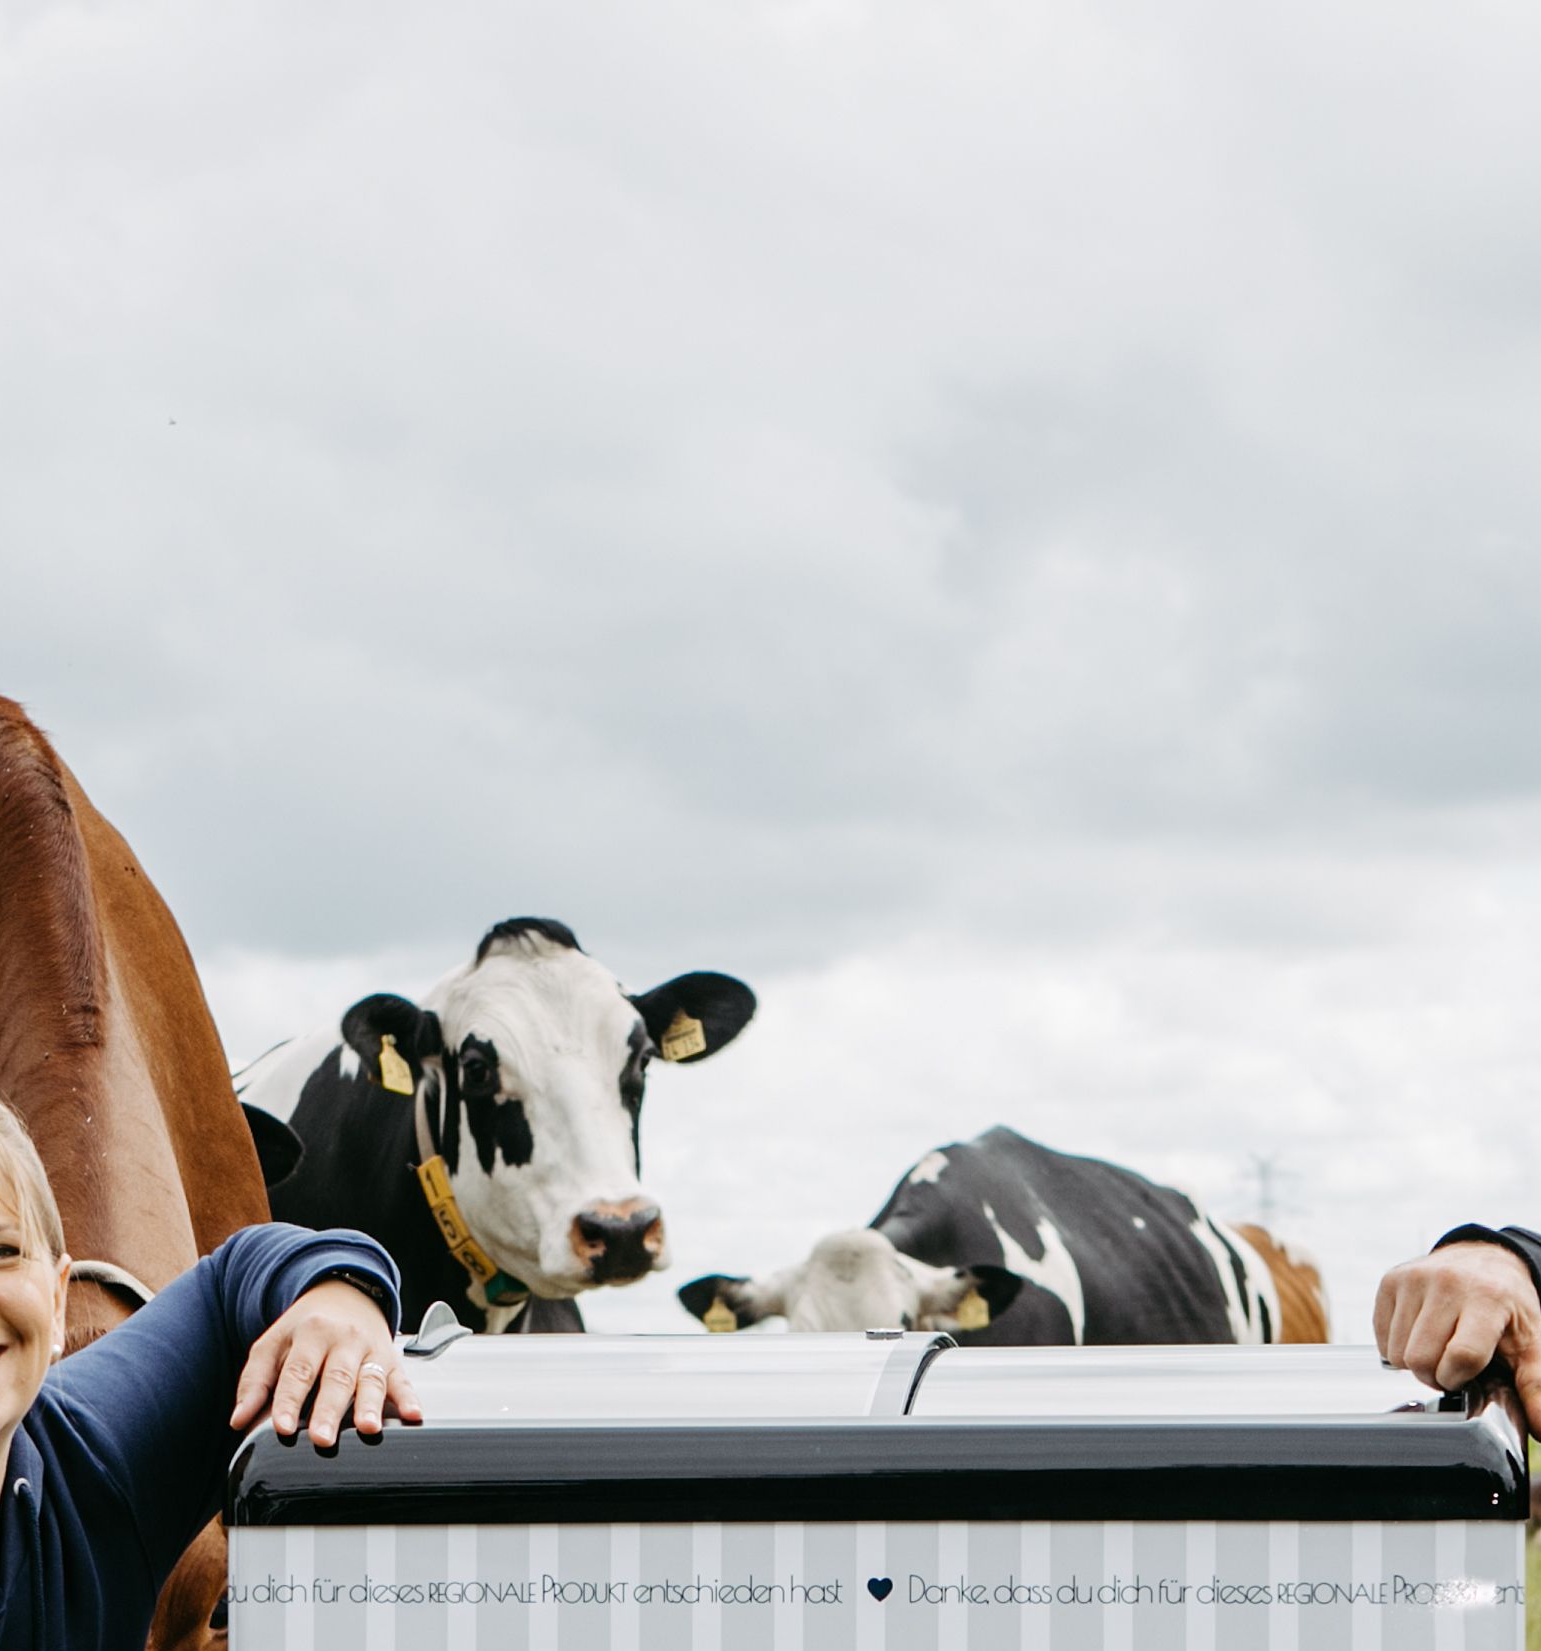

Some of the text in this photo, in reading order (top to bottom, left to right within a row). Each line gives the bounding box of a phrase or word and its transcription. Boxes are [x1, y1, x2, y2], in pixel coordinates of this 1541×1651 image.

[252, 1573, 307, 1604] dich
[312, 1577, 346, 1604] für
[349, 1574, 425, 1604] dieses
[428, 1581, 538, 1605] REGIONALE
[633, 1574, 786, 1605] entschieden
[790, 1574, 843, 1605] hast
[908, 1574, 990, 1607] Danke,
[993, 1574, 1052, 1605] dass
[1056, 1574, 1093, 1605] du
[1096, 1574, 1153, 1605] dich
[1158, 1579, 1193, 1605] für
[1195, 1574, 1274, 1606] dieses
[1277, 1581, 1387, 1605] REGIONALE
